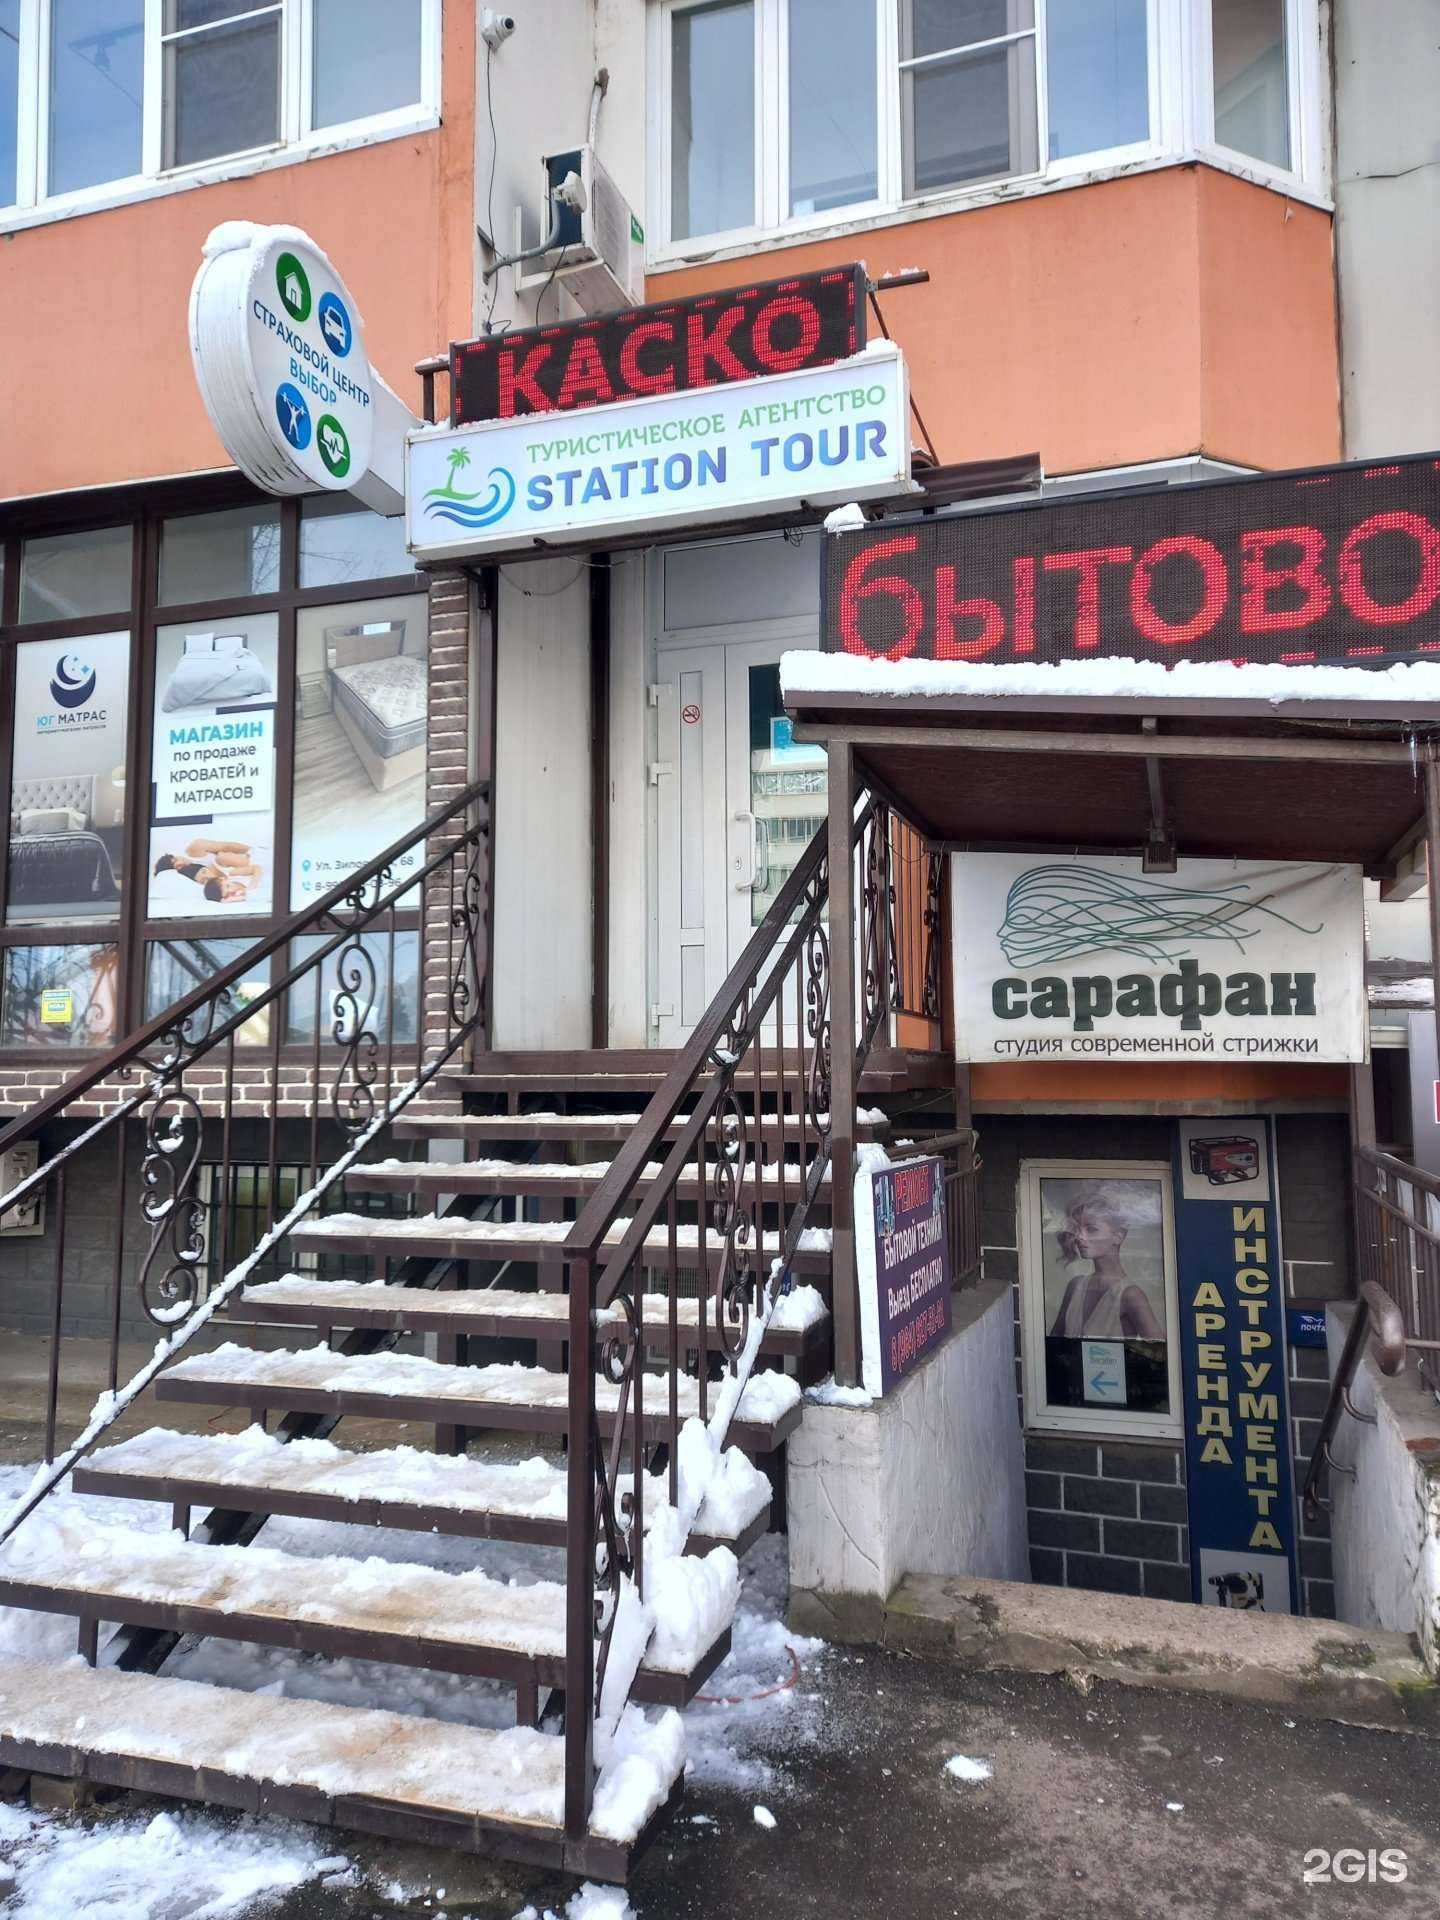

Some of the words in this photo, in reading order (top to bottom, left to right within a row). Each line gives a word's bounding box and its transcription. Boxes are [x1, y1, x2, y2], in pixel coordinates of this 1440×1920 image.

[253, 300, 329, 377] СТРАХОВОЙ
[332, 366, 370, 407] ЦЕНТР
[496, 296, 821, 417] КАСКО
[289, 357, 337, 404] ВЫБОР
[527, 413, 726, 462] ТУРИСТИЧЕСКОЕ
[738, 385, 886, 430] АГЕНТСТВО
[526, 446, 726, 511] STATION
[751, 419, 888, 477] TOUR
[37, 715, 55, 727] ЮГ
[58, 710, 107, 724] МАТРАС
[170, 721, 263, 745] МАГАЗИН
[170, 763, 246, 783] КРОВАТЕЙ
[250, 766, 259, 777] и
[173, 751, 191, 761] по
[194, 745, 256, 762] продаже
[174, 786, 254, 804] МАТРАСОВ
[400, 856, 414, 866] 68
[992, 959, 1317, 1031] сарафан
[993, 1037, 1063, 1056] студия
[1071, 1032, 1215, 1055] современной
[1223, 1036, 1319, 1055] стрижки
[895, 1165, 929, 1215] РЕМОНТ
[884, 1218, 917, 1270] БЫТОВОЙ
[917, 1214, 942, 1252] ТЕХНИКИ
[887, 1285, 911, 1320] Выезд
[910, 1256, 943, 1303] БЕСПЛАТНО
[1192, 1282, 1233, 1465] АРЕНДА
[1232, 1207, 1282, 1549] ИНСТРУМЕНТА
